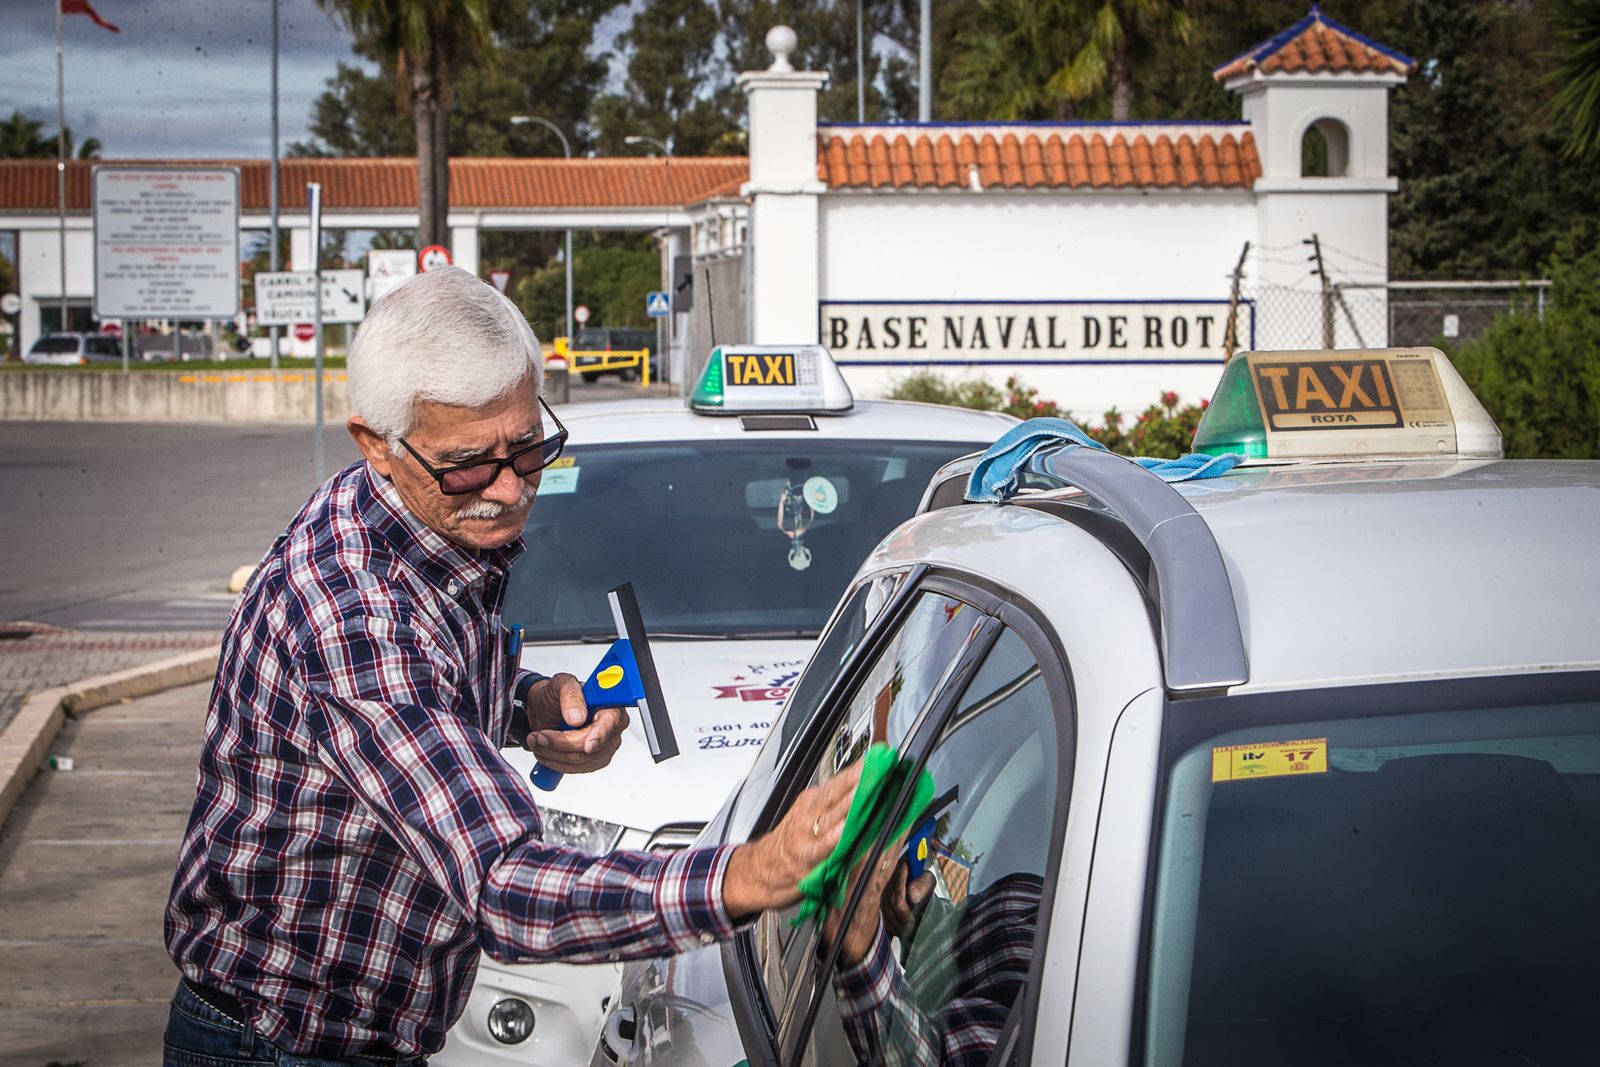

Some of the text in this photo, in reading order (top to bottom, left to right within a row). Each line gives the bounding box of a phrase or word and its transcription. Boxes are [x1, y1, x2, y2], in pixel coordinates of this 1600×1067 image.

[306, 276, 337, 285] PRA
[267, 289, 331, 299] CAMIONS
[306, 308, 337, 318] LNE
[830, 317, 928, 349] BASE
[943, 317, 1067, 348] NAVAL
[1080, 316, 1129, 347] DE
[728, 356, 793, 384] TAXI
[1259, 364, 1392, 410] TAXI
[1311, 414, 1358, 423] ROTA
[750, 721, 774, 729] 40
[1284, 751, 1314, 762] 17
